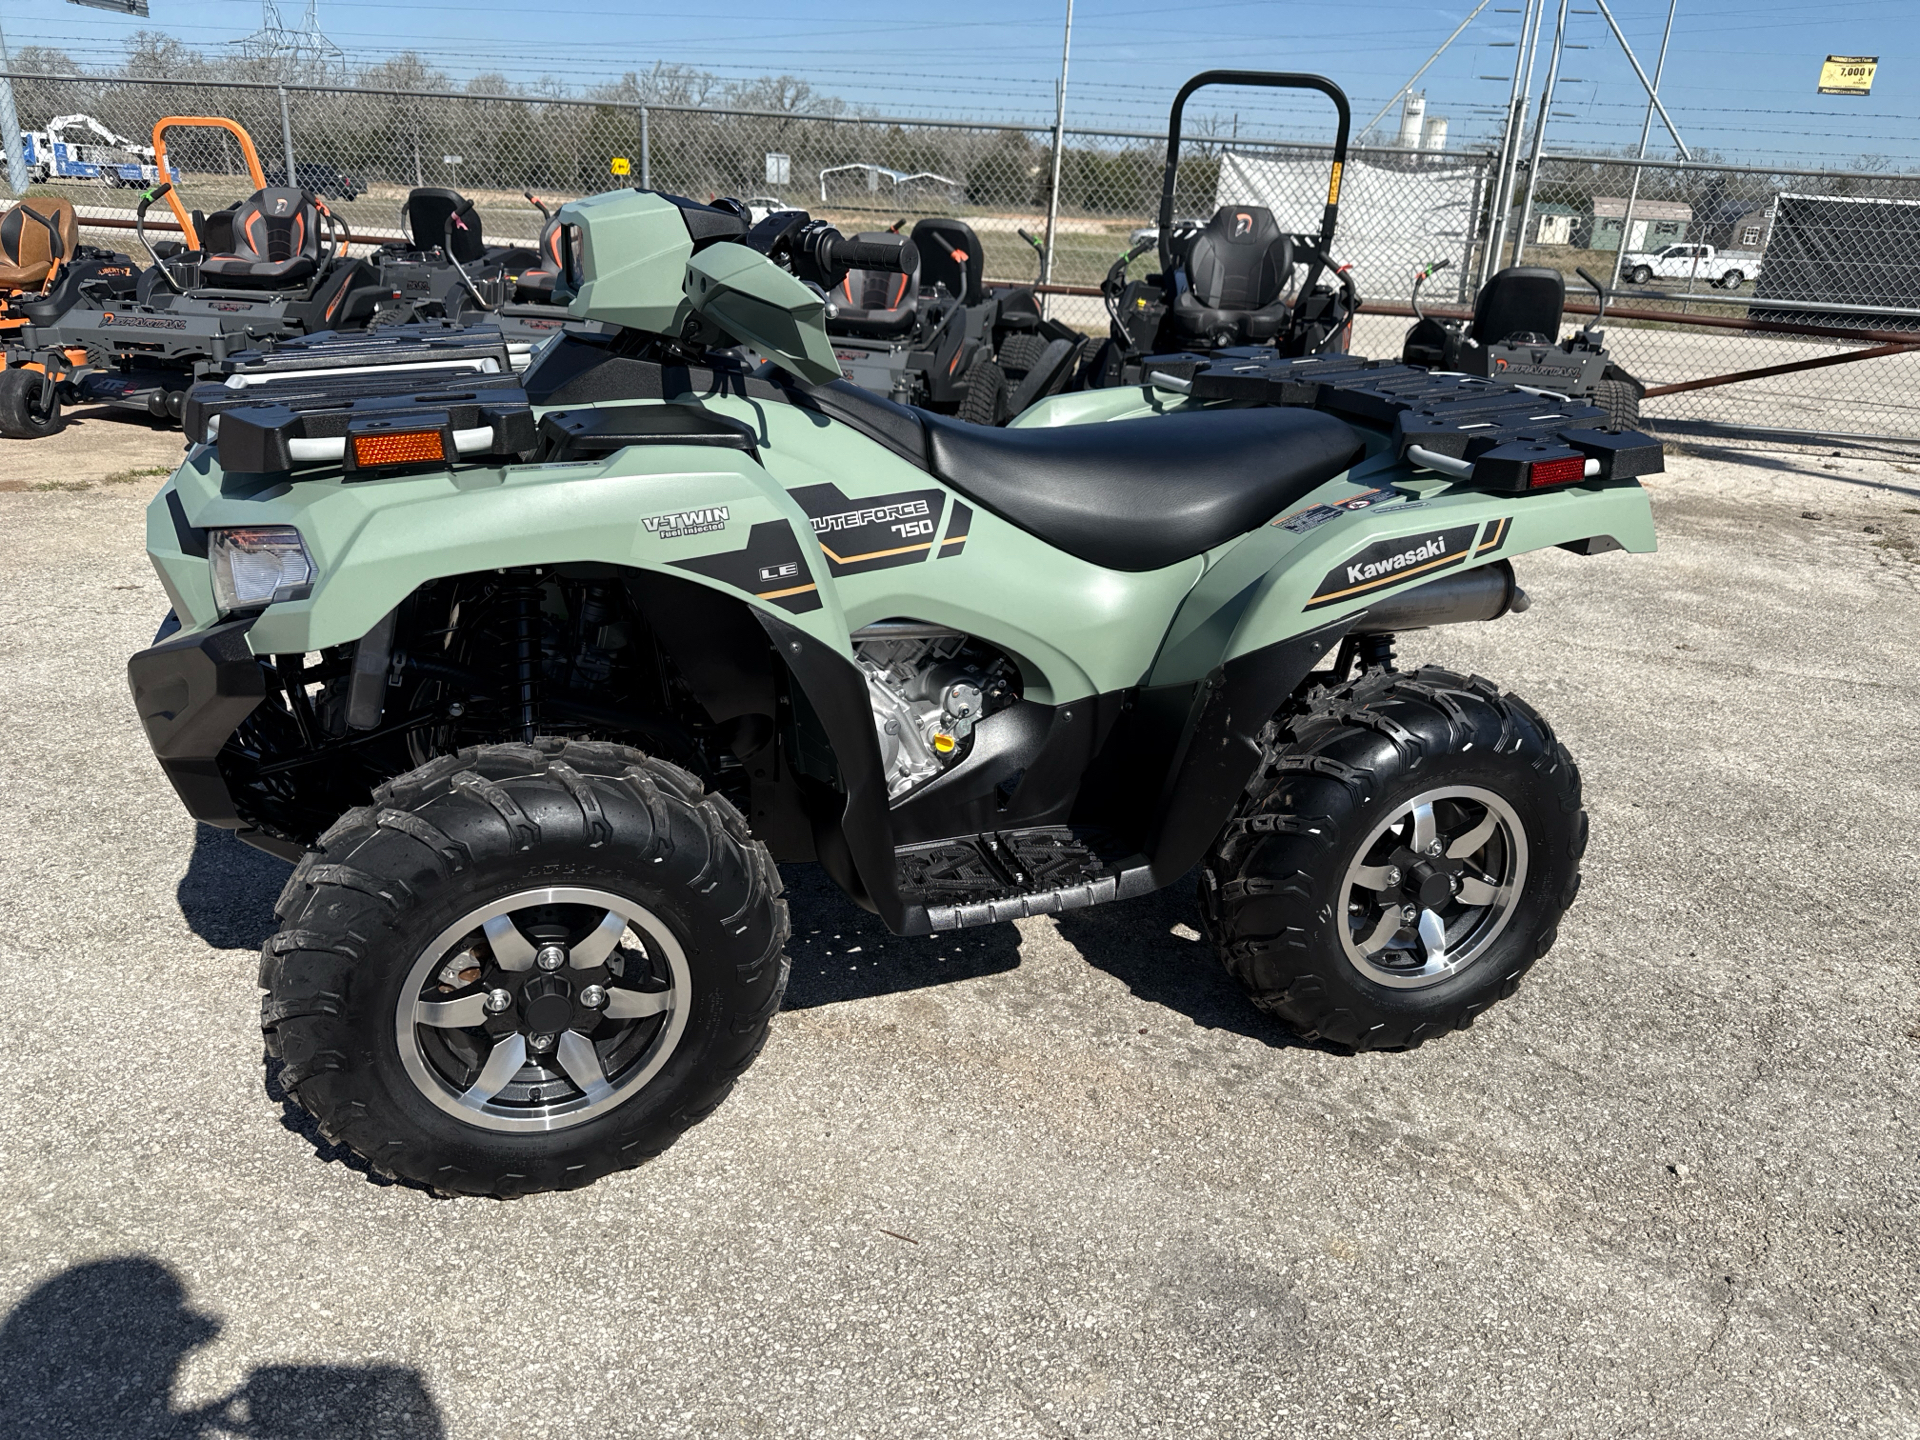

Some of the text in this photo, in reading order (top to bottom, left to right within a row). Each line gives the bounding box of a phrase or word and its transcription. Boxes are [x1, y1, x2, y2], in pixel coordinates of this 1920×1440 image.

[1840, 67, 1874, 77] 7,000 V
[113, 316, 187, 330] SPARTAN
[1507, 363, 1581, 378] SPARTAN
[641, 506, 730, 532] V-TWIN
[809, 510, 860, 534] UTE
[660, 522, 725, 539] Fuel Injected
[891, 519, 934, 538] 750
[1346, 536, 1446, 584] Kawasaki
[761, 564, 798, 580] LE
